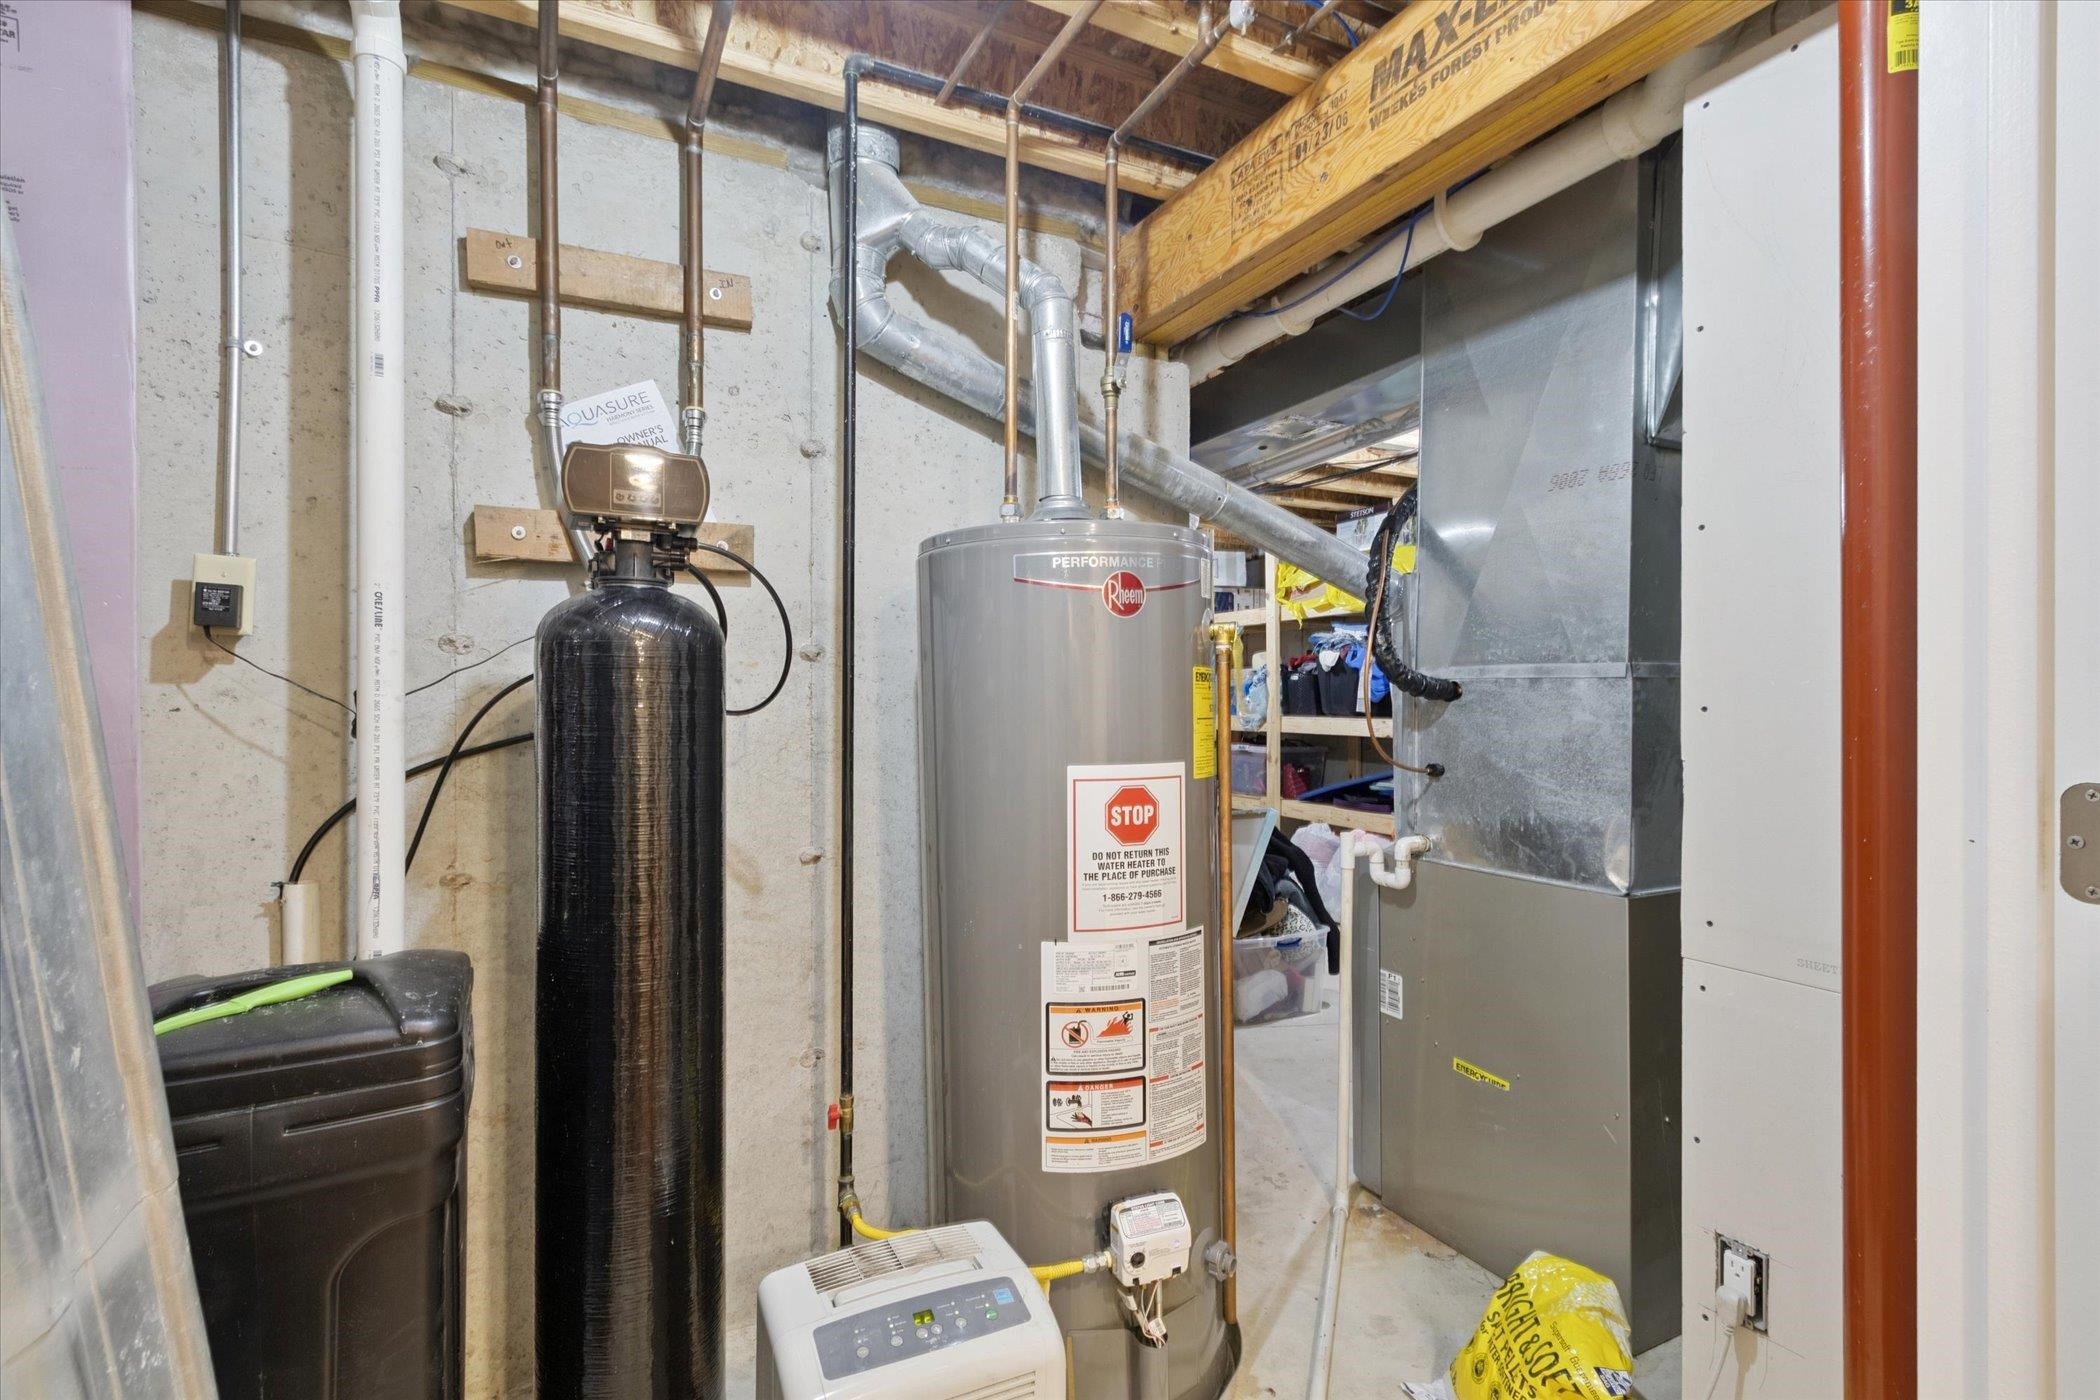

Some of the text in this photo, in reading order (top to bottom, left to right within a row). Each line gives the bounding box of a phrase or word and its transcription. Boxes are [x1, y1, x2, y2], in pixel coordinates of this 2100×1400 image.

[1370, 0, 1507, 104] MAX-L
[1368, 82, 1427, 131] WEEKES
[1430, 34, 1491, 89] FOREST
[1496, 0, 1557, 44] PROD
[616, 424, 664, 445] OWNER'S
[1350, 506, 1374, 519] STETSON
[1052, 555, 1154, 569] PERFORMANCE
[1107, 572, 1145, 610] Rheem
[1110, 804, 1155, 827] STOP
[1092, 847, 1169, 861] DO NOT RETURN THIS
[1097, 858, 1166, 871] WATER HEATER TO
[1083, 867, 1176, 882] THE PLACE OF PURCHASE
[1102, 889, 1162, 902] 1-866-279-4566
[1084, 1005, 1119, 1014] WARNING
[1519, 1333, 1540, 1359] &
